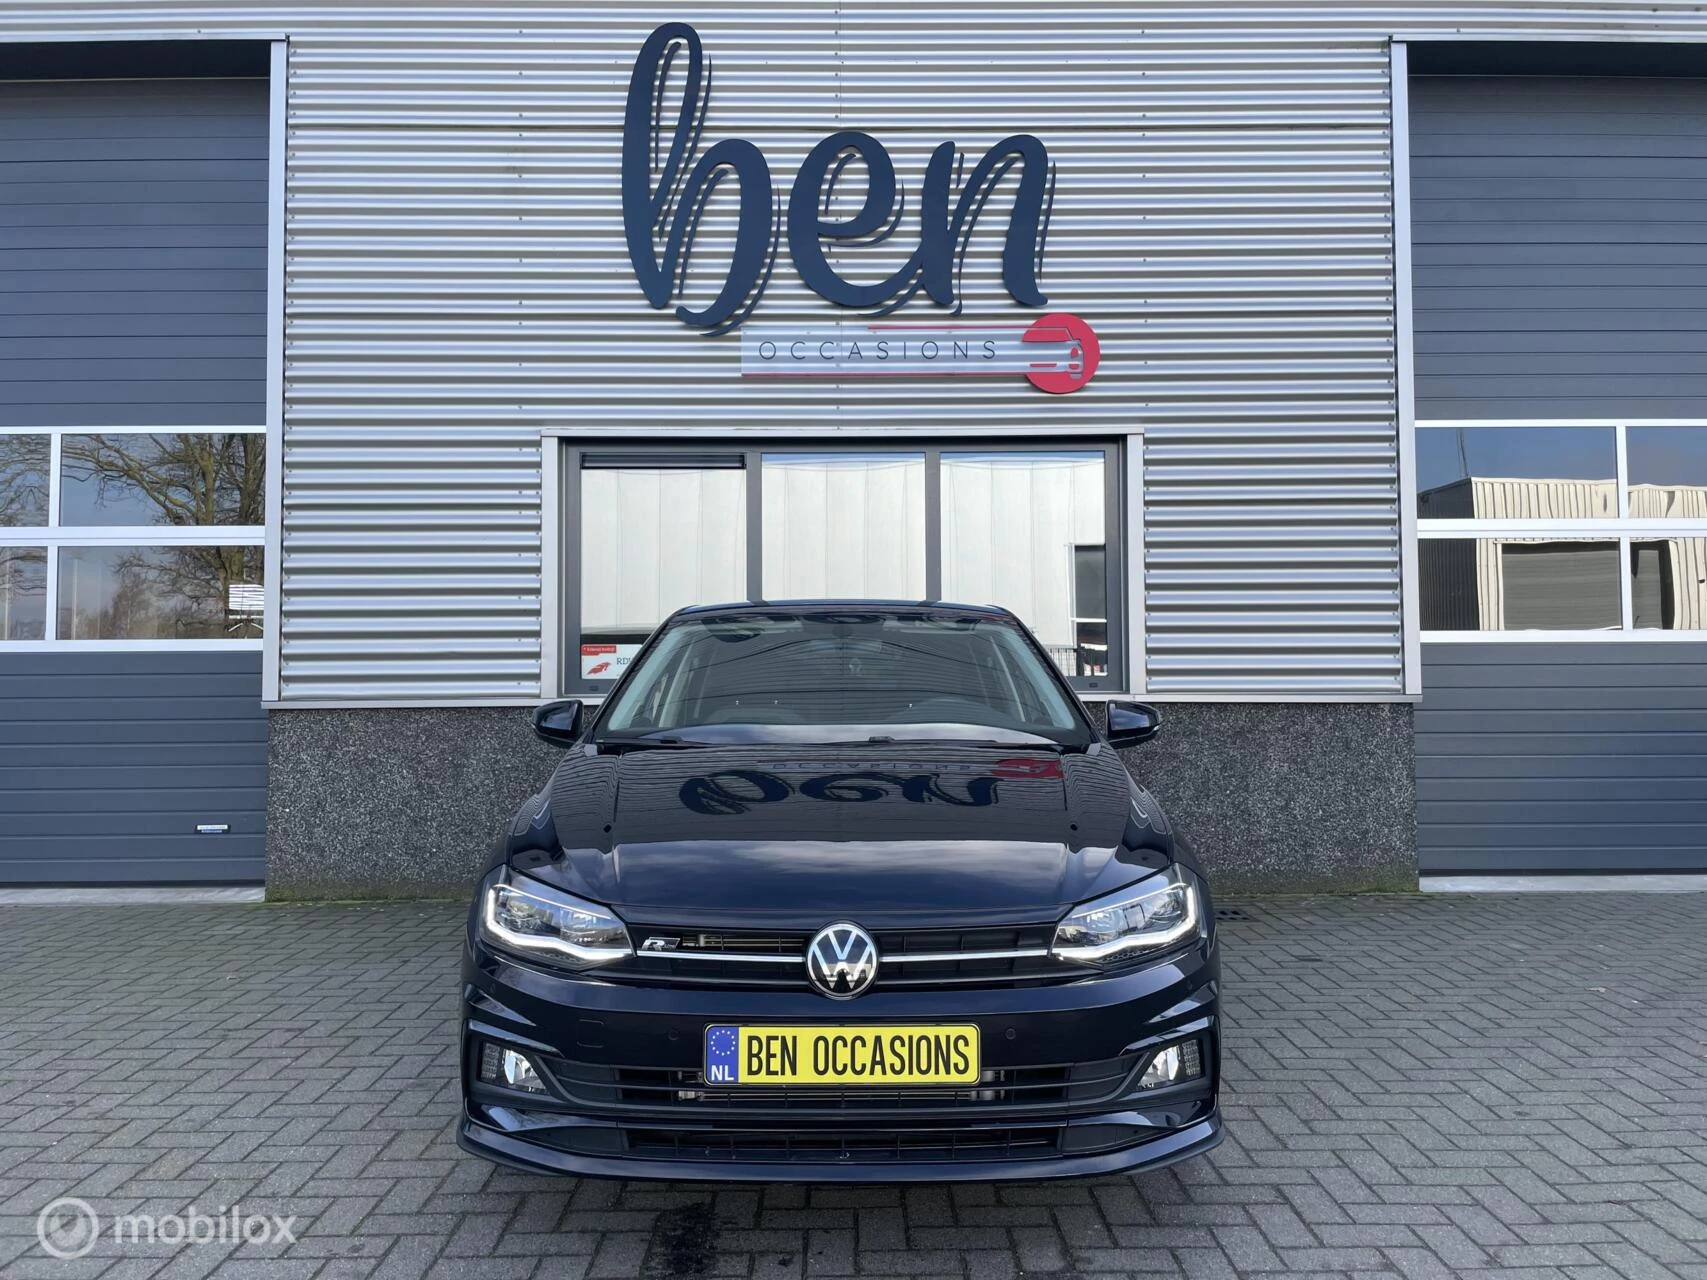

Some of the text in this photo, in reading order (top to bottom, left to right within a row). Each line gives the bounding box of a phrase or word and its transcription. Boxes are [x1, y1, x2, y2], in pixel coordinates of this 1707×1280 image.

[622, 22, 1056, 335] ben
[758, 341, 997, 360] OCCASIONS
[616, 657, 631, 665] RD
[747, 1034, 970, 1076] BEN OCCASIONS
[711, 1066, 734, 1081] NL
